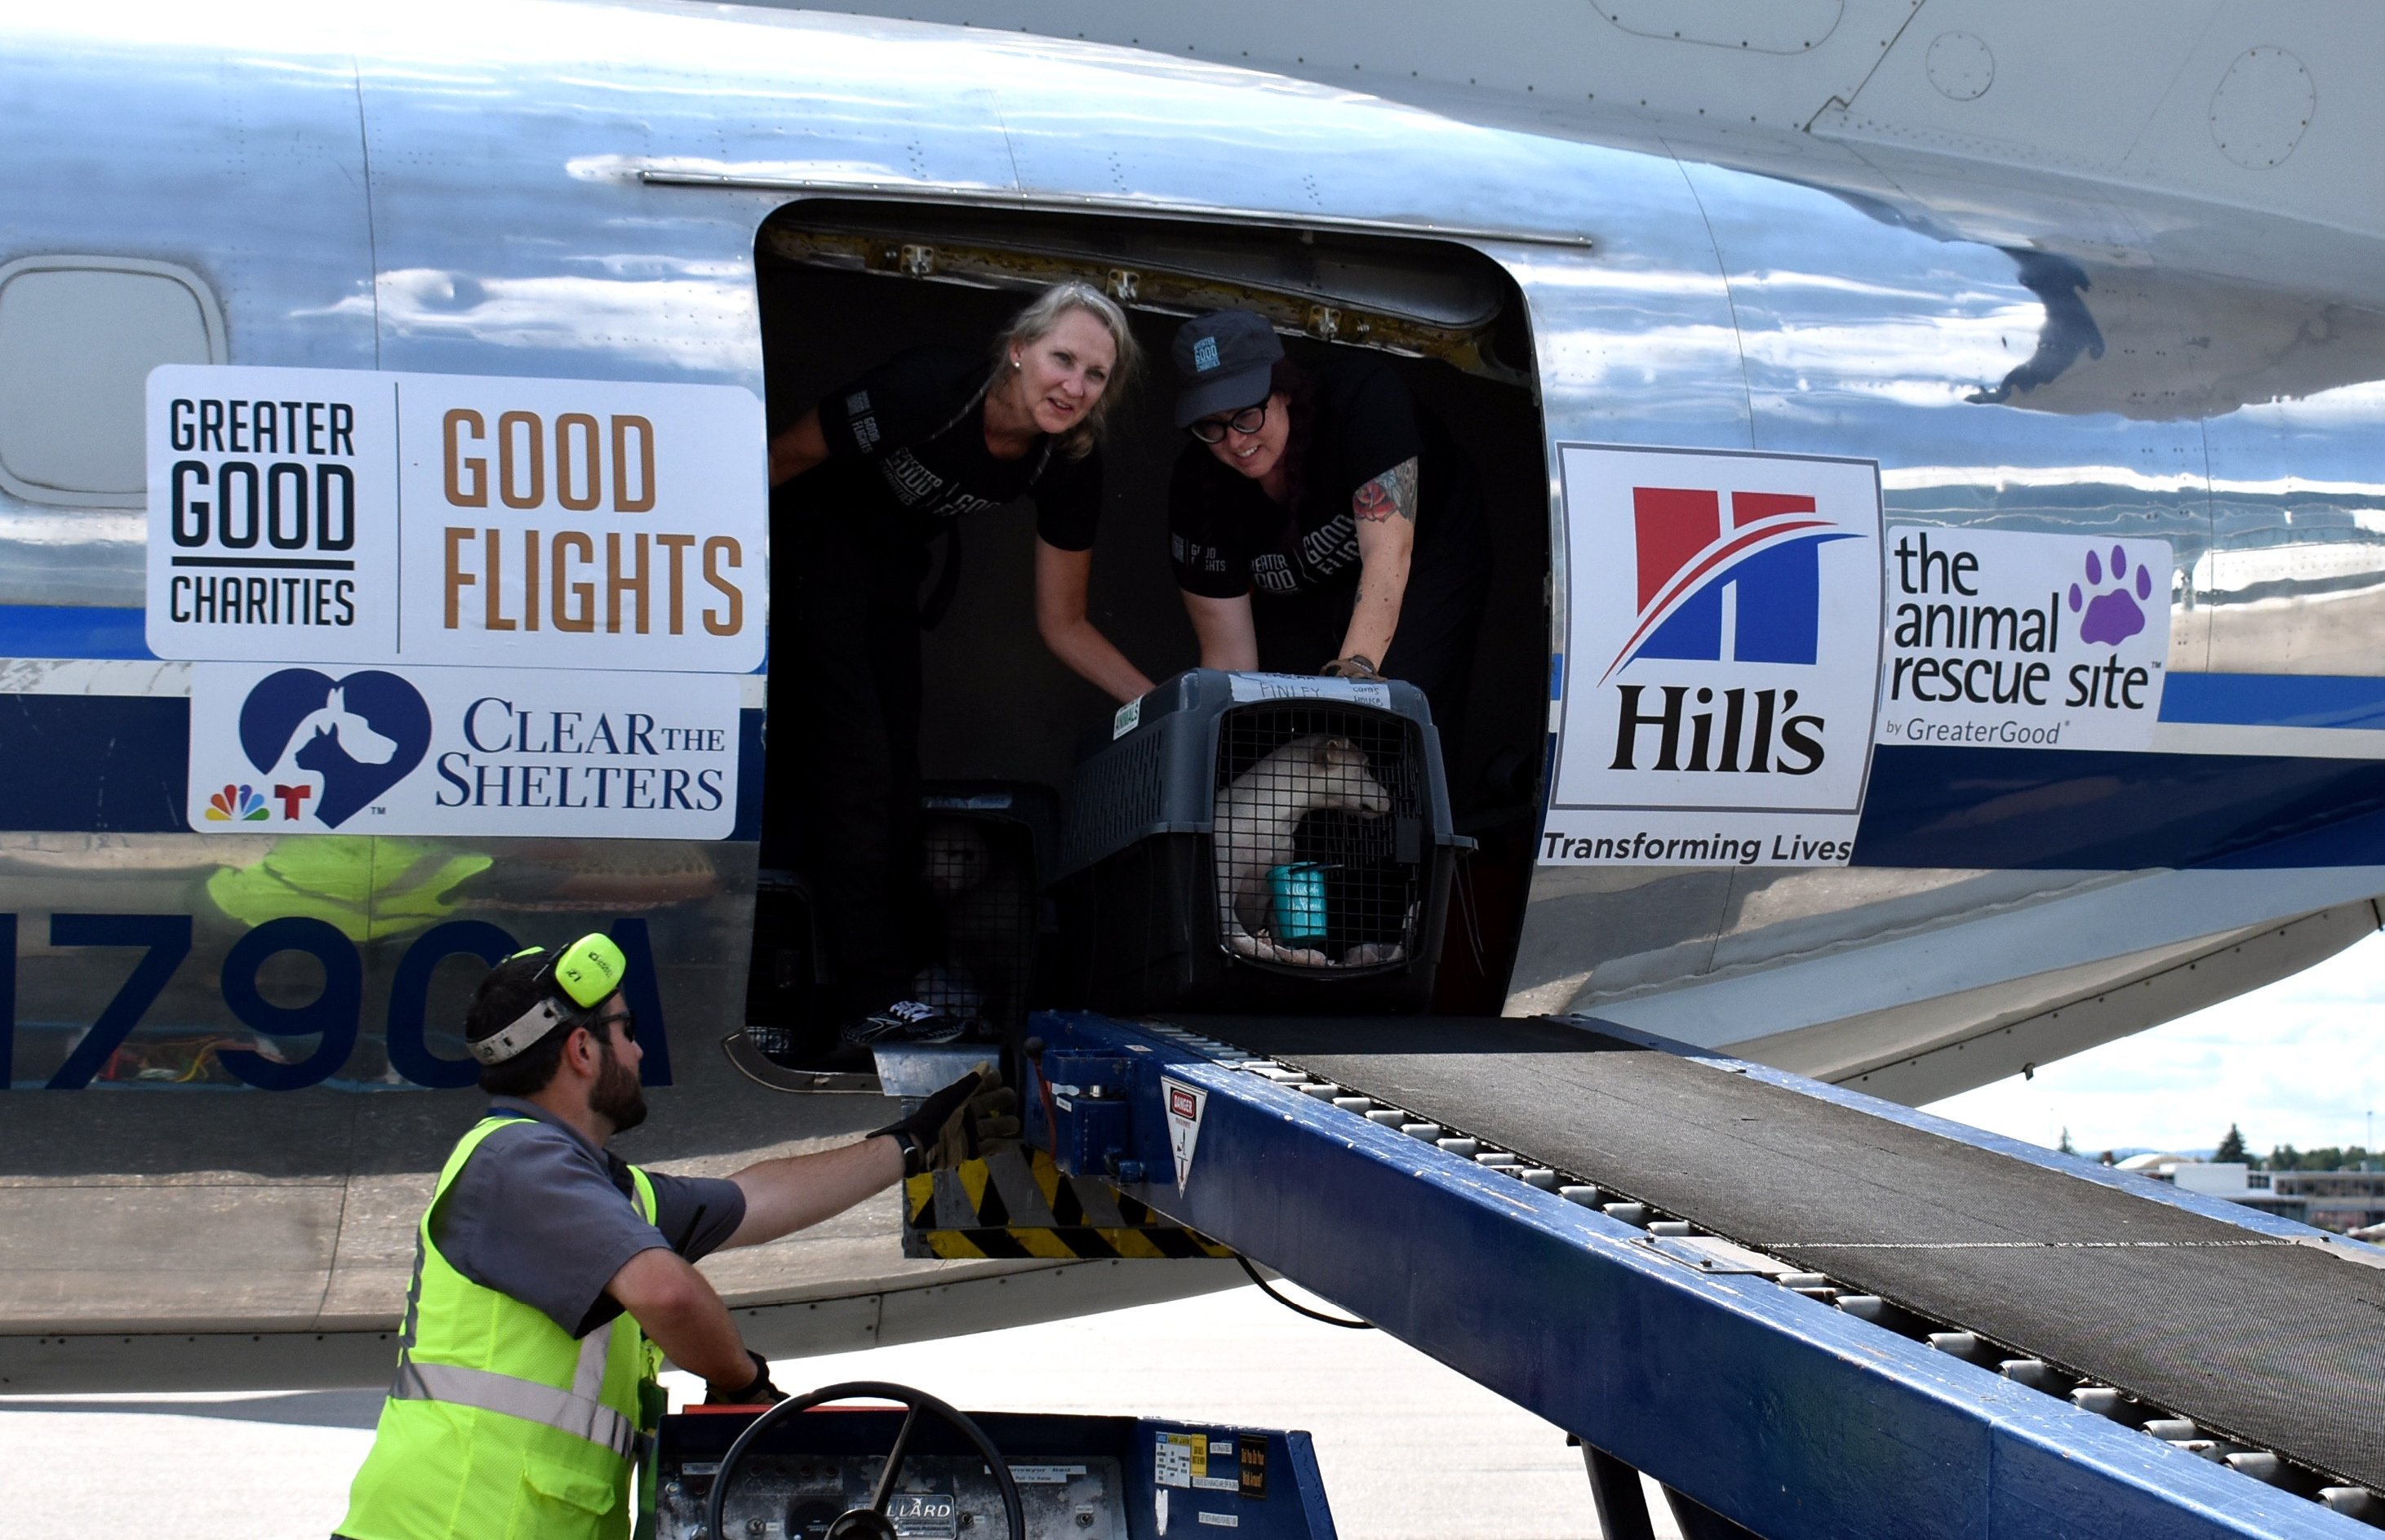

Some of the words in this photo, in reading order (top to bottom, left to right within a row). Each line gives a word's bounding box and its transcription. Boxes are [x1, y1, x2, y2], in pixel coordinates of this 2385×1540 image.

[171, 398, 355, 456] GREATER
[442, 408, 656, 513] GOOD
[171, 459, 355, 552] GOOD
[443, 526, 744, 637] FLIGHTS
[1894, 532, 1979, 597] the
[171, 575, 355, 626] CHARITIES
[1894, 592, 2059, 654] animal
[1890, 656, 2050, 707] rescue
[661, 728, 726, 752] THE
[1607, 684, 1825, 776] Hill's
[1886, 721, 1902, 734] by
[1907, 718, 2060, 744] GreaterGood
[1543, 832, 1762, 865] Transforming
[1770, 834, 1853, 861] Lives
